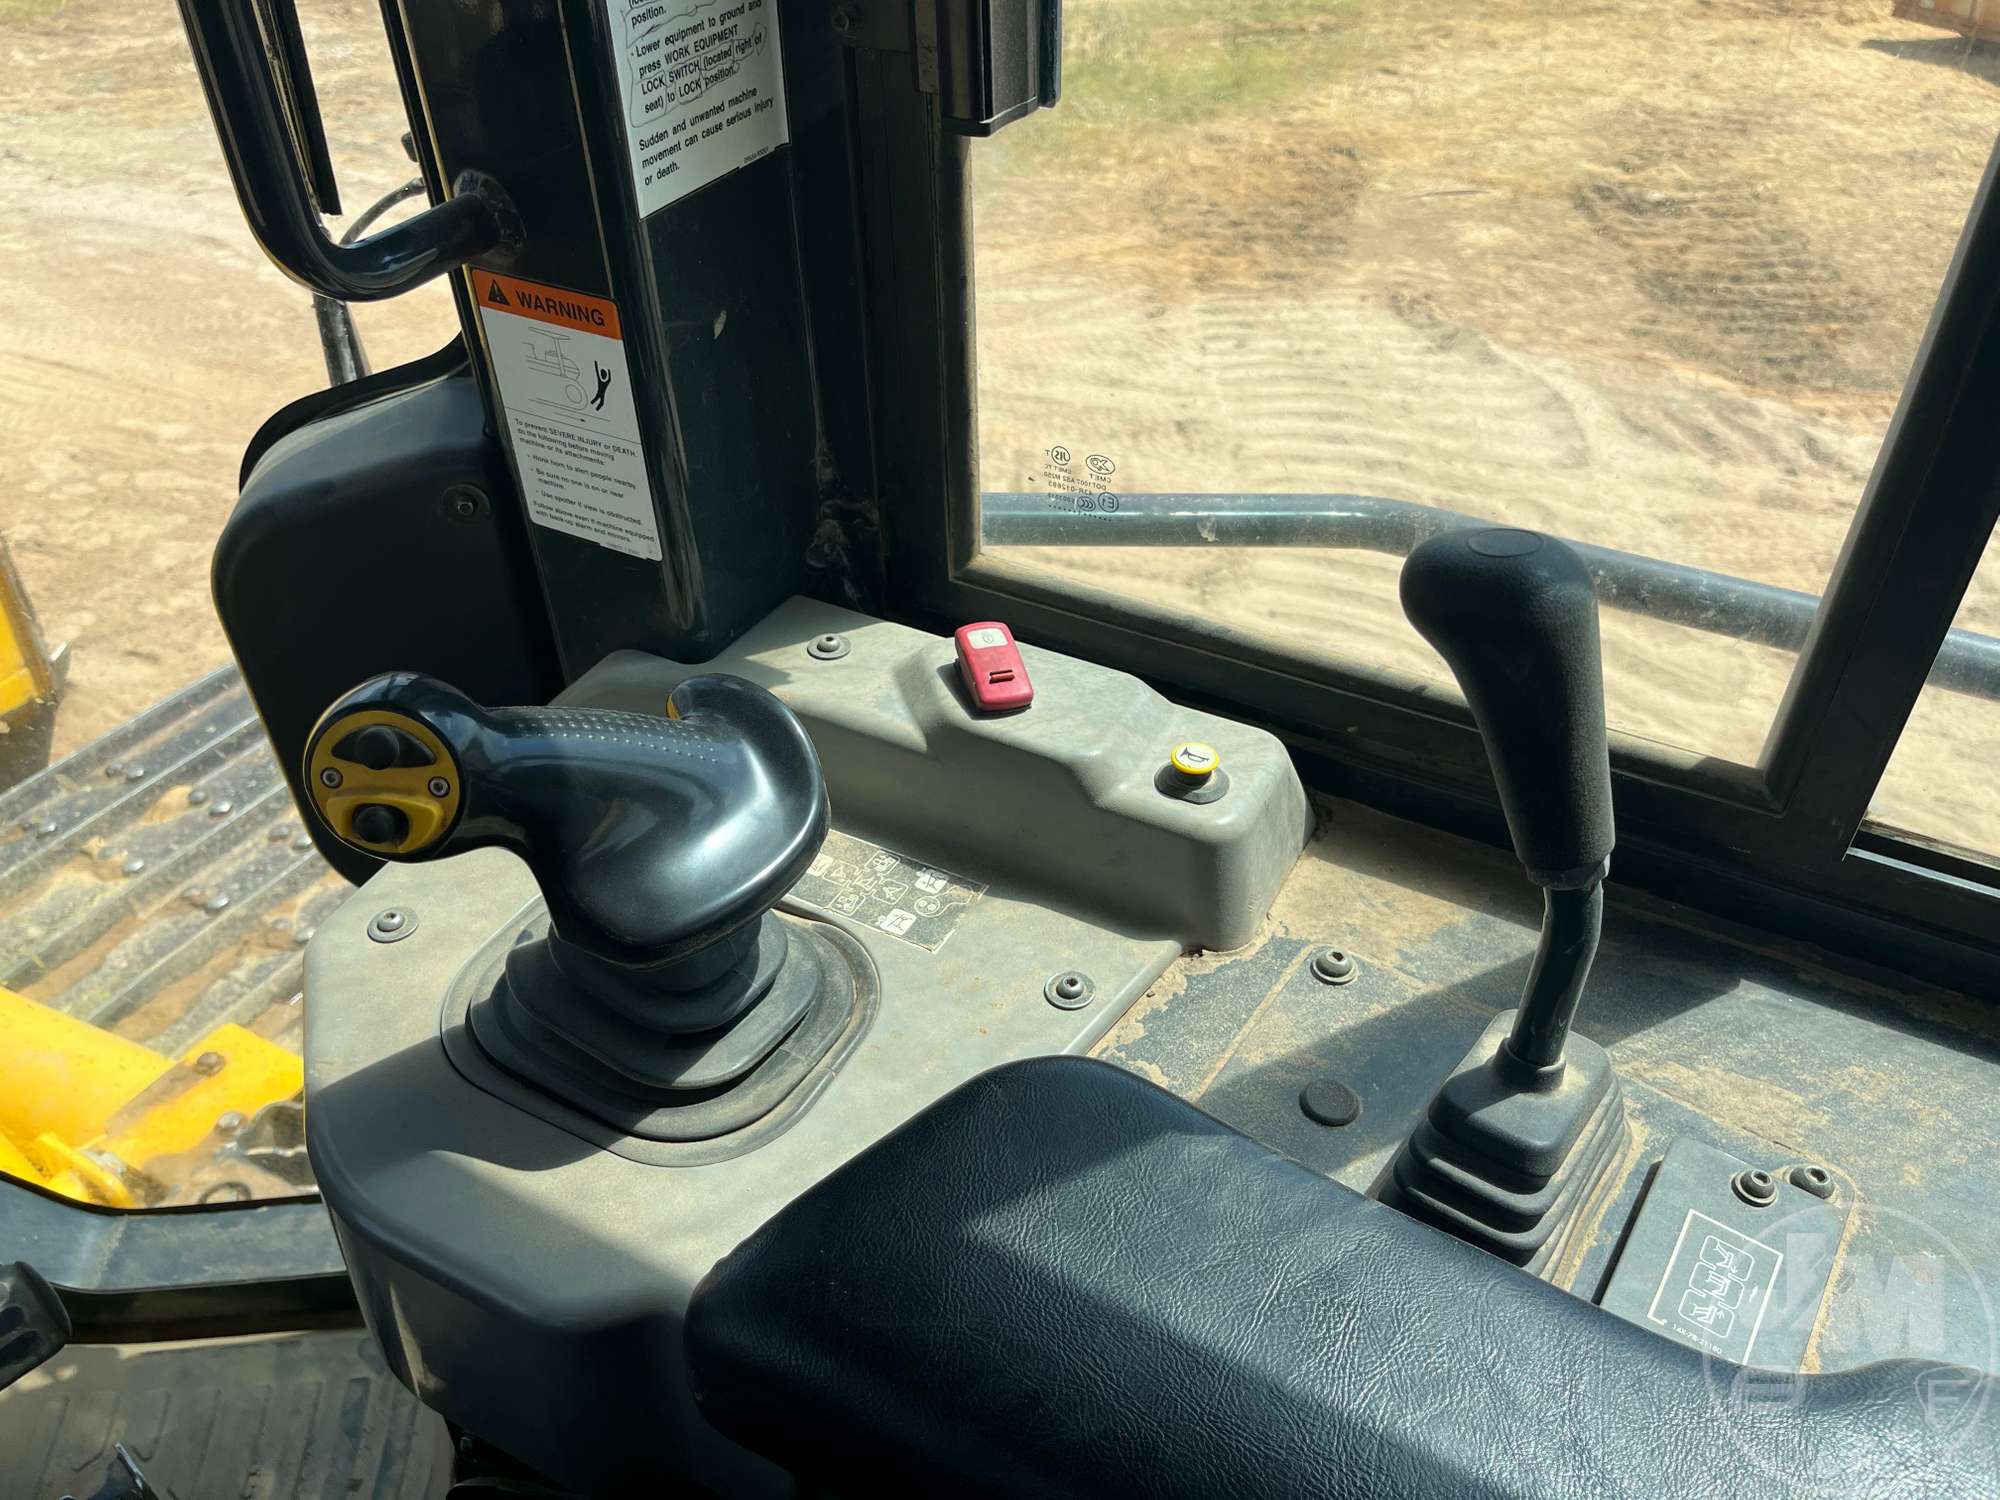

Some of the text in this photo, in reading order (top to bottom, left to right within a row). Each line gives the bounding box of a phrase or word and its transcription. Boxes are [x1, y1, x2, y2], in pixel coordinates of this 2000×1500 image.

[631, 5, 667, 29] position.
[636, 0, 762, 57] Lower equipment to ground and
[639, 24, 739, 79] press WORK EQUIPMENT
[641, 32, 763, 95] LOCK SWITCH (located right of
[644, 66, 737, 114] seat) to LOCK position.
[639, 87, 758, 151] Sudden and unwanted machine
[641, 97, 774, 169] movement can cause serious injury
[644, 164, 680, 186] or death.
[515, 290, 606, 327] WARNING
[519, 437, 546, 449] machine
[554, 446, 563, 454] its
[524, 422, 548, 433] prevent
[549, 428, 576, 440] SEVERE
[577, 436, 602, 448] INJURY
[537, 432, 568, 448] following
[568, 442, 588, 453] before
[590, 448, 615, 461] moving
[532, 454, 549, 464] Honk
[550, 458, 566, 469] horn
[566, 463, 574, 471] to
[574, 466, 589, 475] alert
[590, 470, 612, 482] people
[546, 472, 560, 481] sure
[541, 490, 553, 499] Use
[554, 495, 576, 506] spotter
[555, 507, 573, 517] above
[596, 519, 624, 532] machine
[624, 528, 655, 542] equipped
